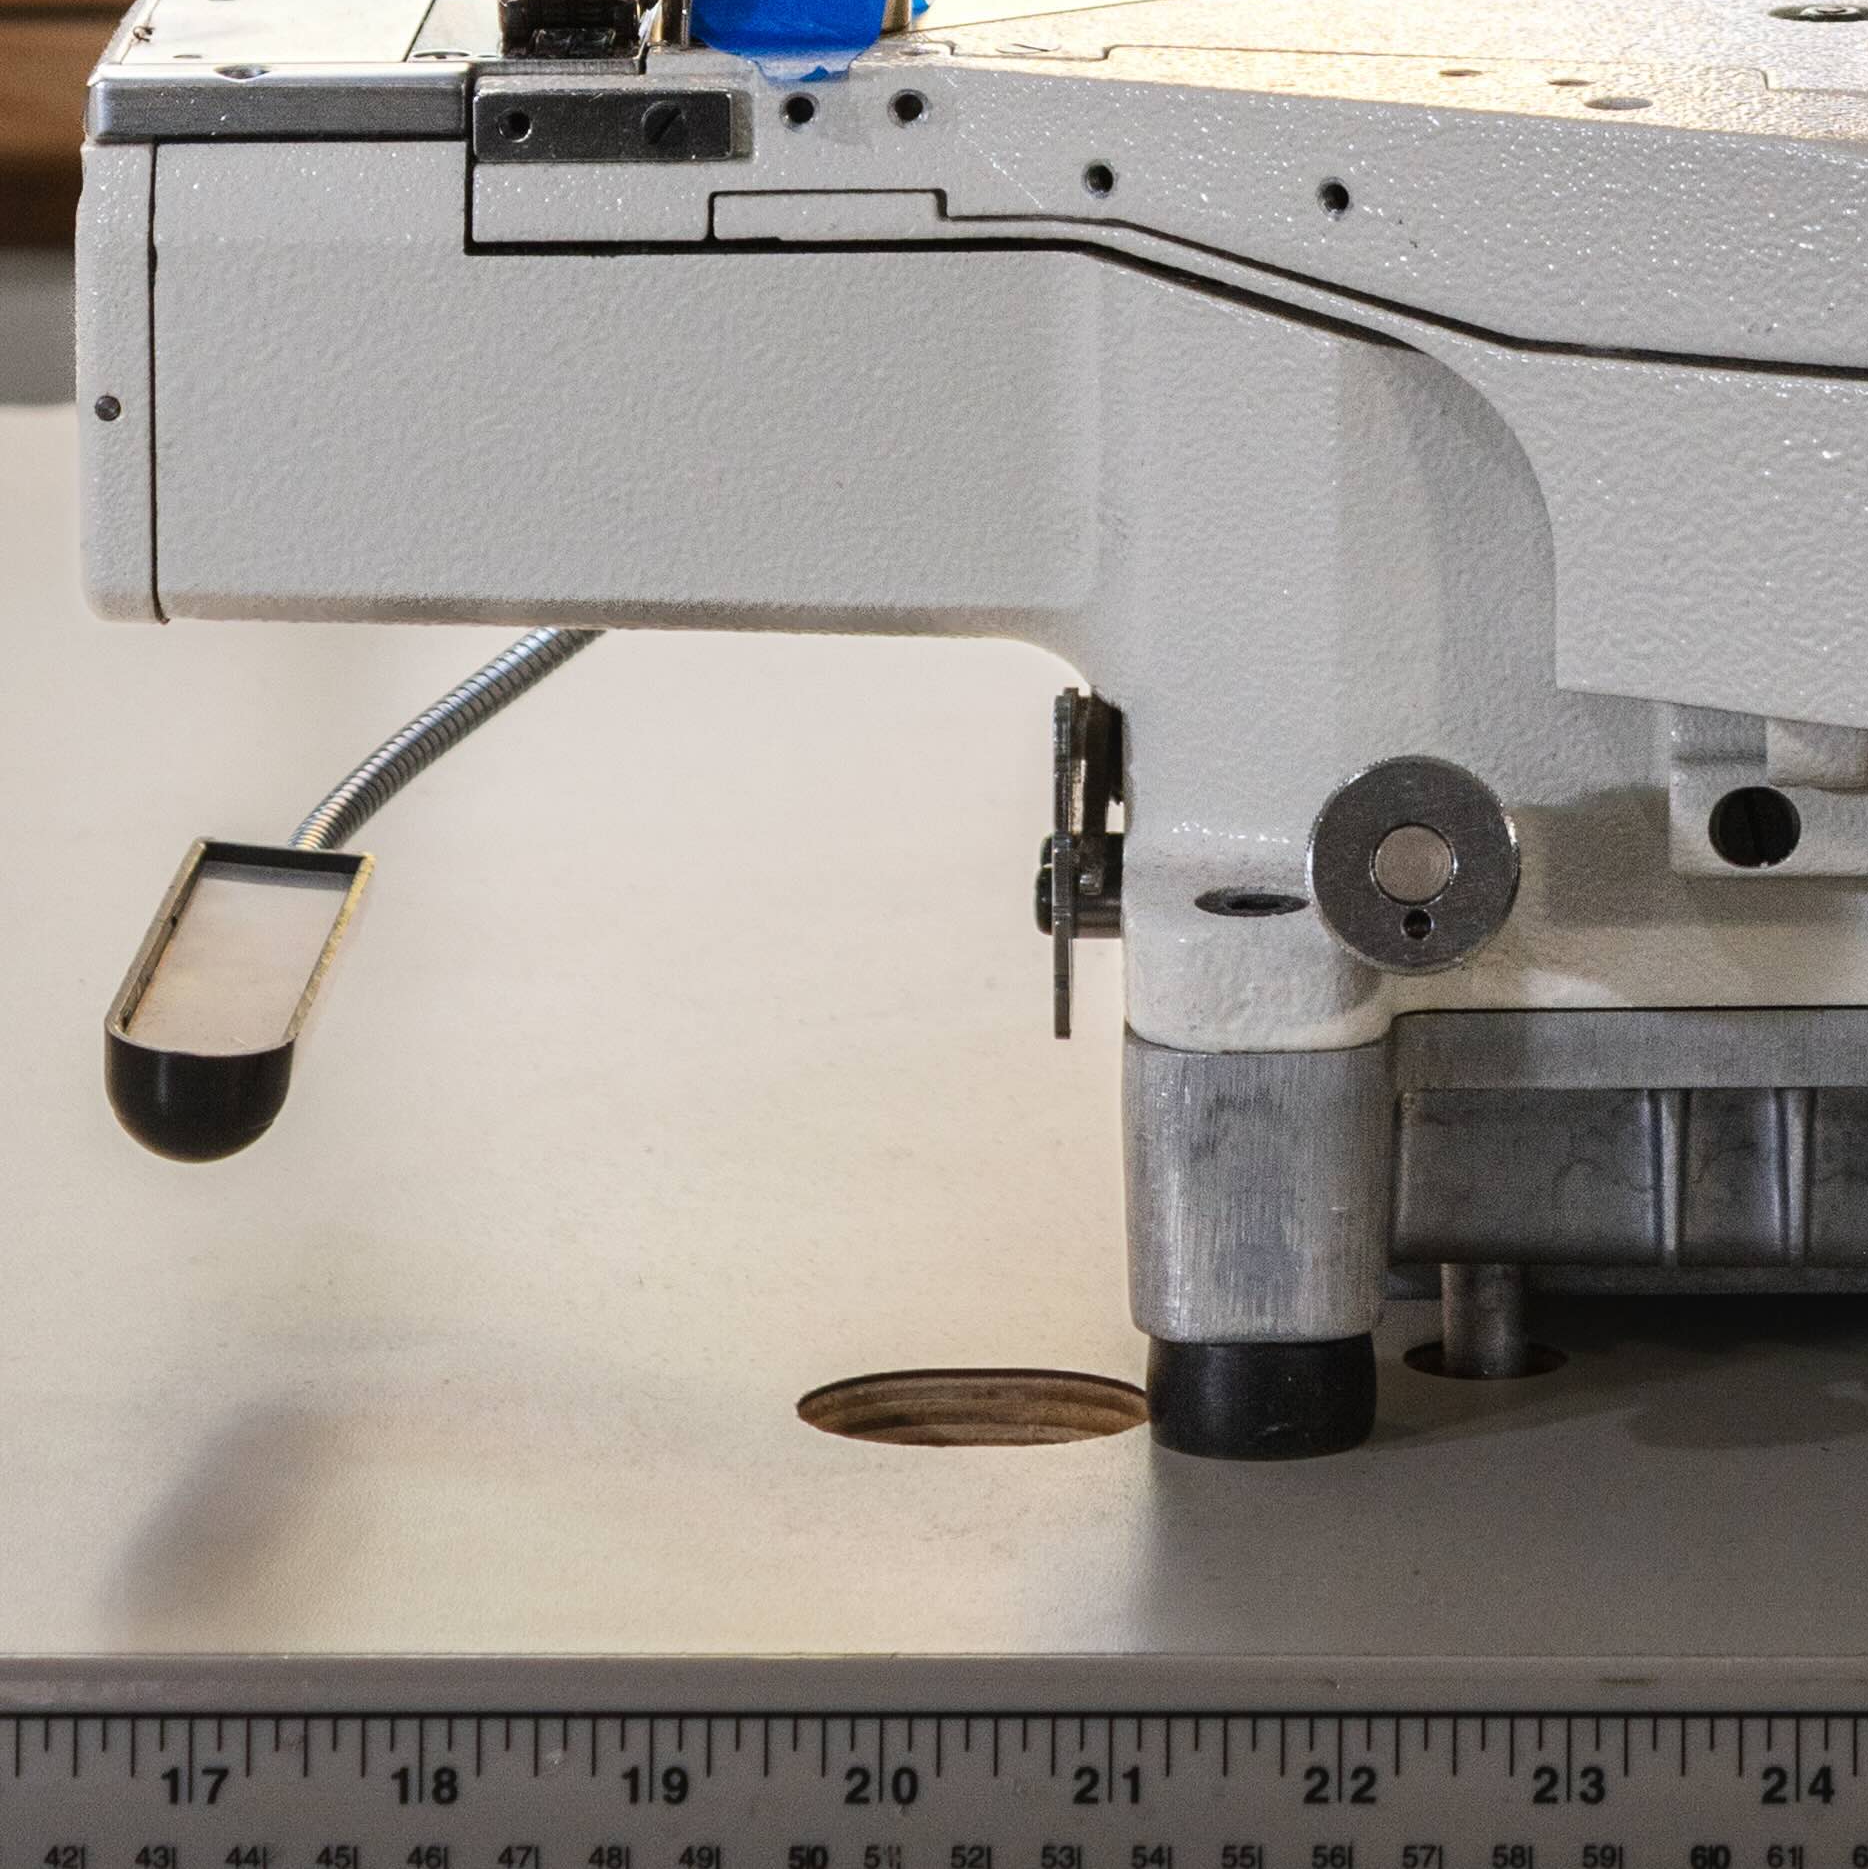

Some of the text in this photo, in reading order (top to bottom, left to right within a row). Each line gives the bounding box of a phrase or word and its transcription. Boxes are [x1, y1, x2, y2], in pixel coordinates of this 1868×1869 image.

[162, 1767, 229, 1805] 17
[392, 1767, 458, 1805] 18
[622, 1766, 688, 1804] 19
[845, 1766, 918, 1805] 20
[1074, 1766, 1140, 1804] 21
[1304, 1766, 1376, 1804] 22
[1533, 1766, 1605, 1804] 23
[1762, 1766, 1835, 1804] 24
